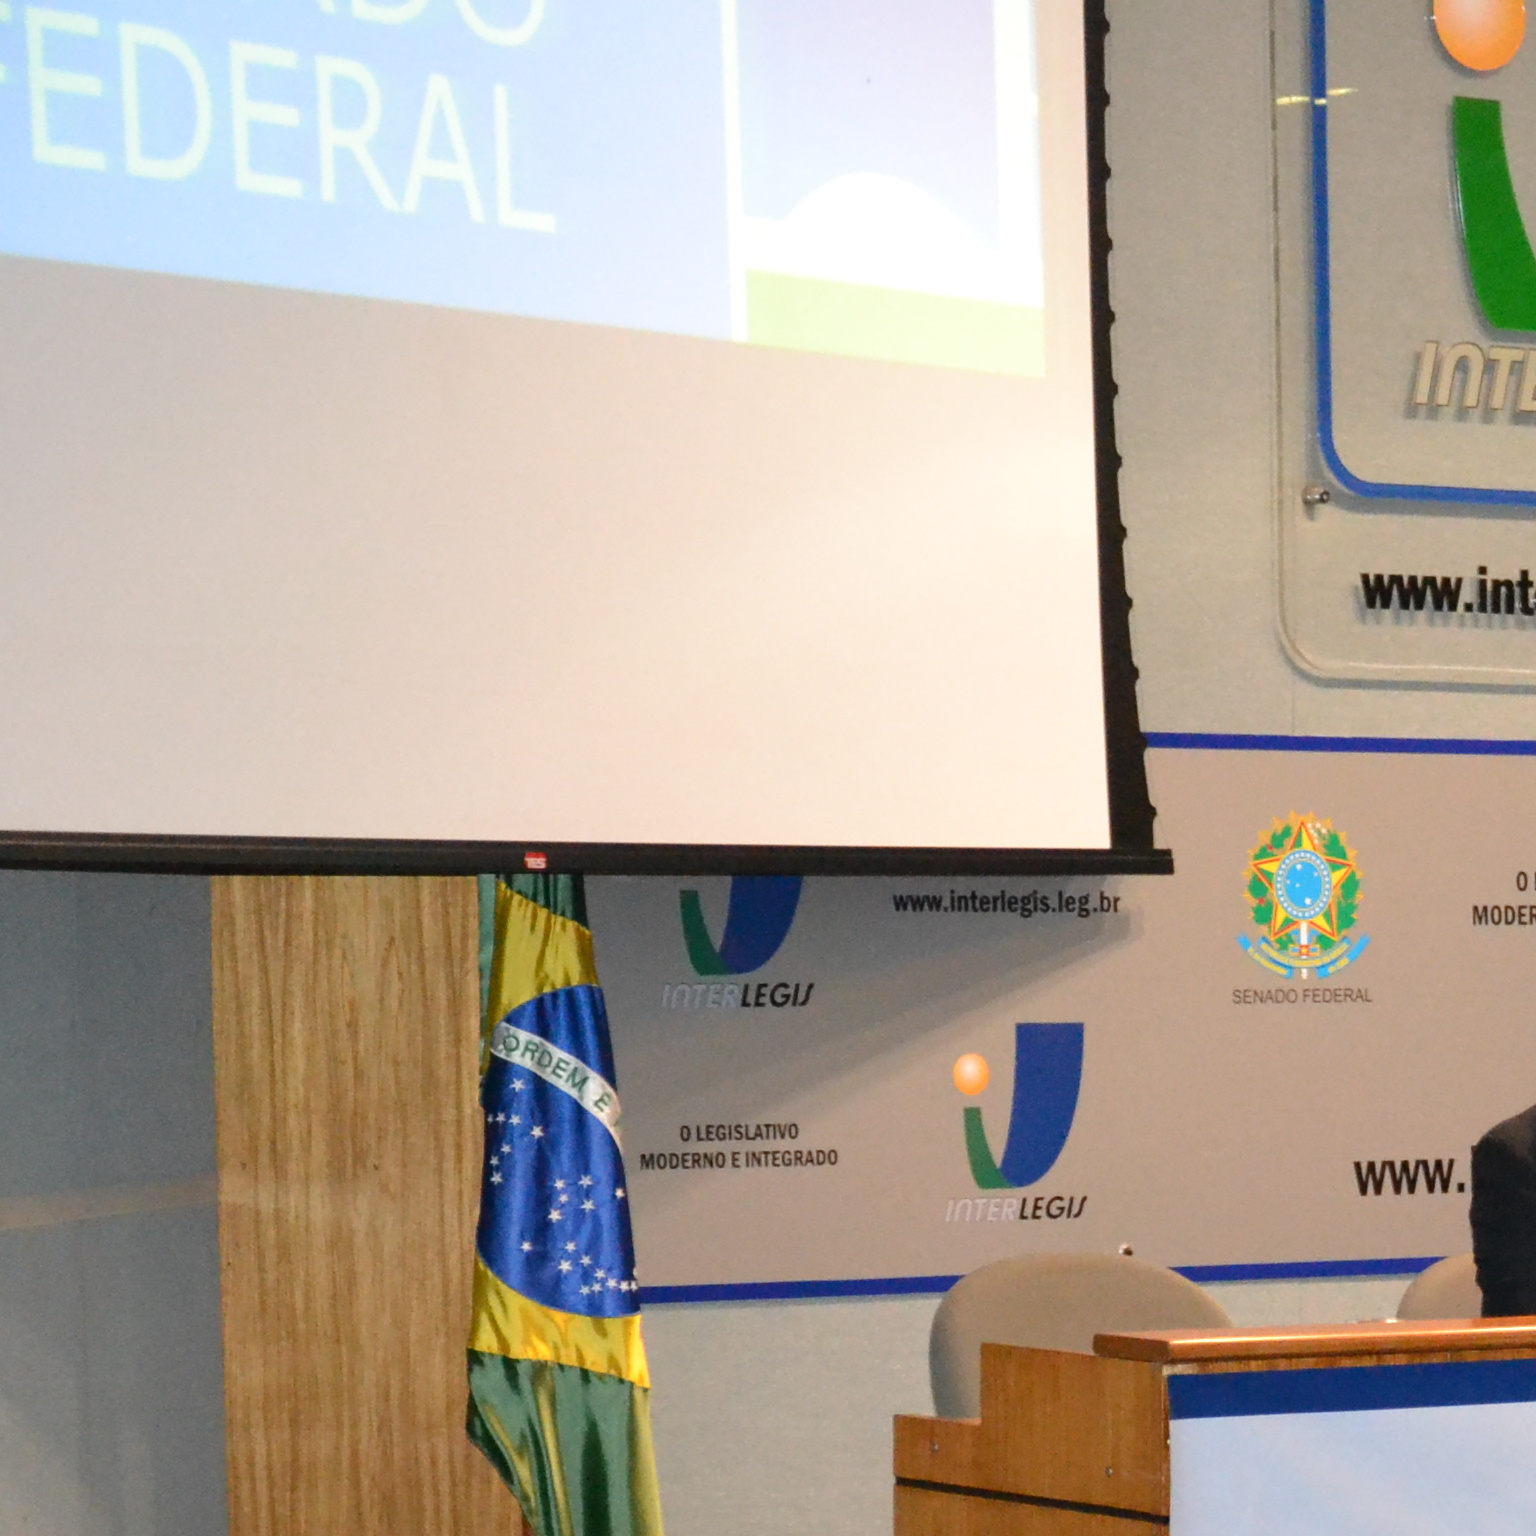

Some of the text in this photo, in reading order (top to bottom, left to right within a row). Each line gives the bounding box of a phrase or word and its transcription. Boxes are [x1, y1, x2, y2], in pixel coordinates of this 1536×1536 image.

[0, 5, 558, 234] EDERAL
[1516, 871, 1529, 892] O
[893, 889, 1121, 919] www.interlegis.leg.br
[661, 982, 815, 1009] INTERLEGIS
[1232, 988, 1373, 1005] SENADO FEDERAL
[503, 1033, 612, 1112] ORDEM E
[680, 1123, 799, 1142] O LEGISLATIVO
[640, 1149, 839, 1170] MODERNO E INTEGRADO
[944, 1195, 1087, 1222] INTERLEGIS
